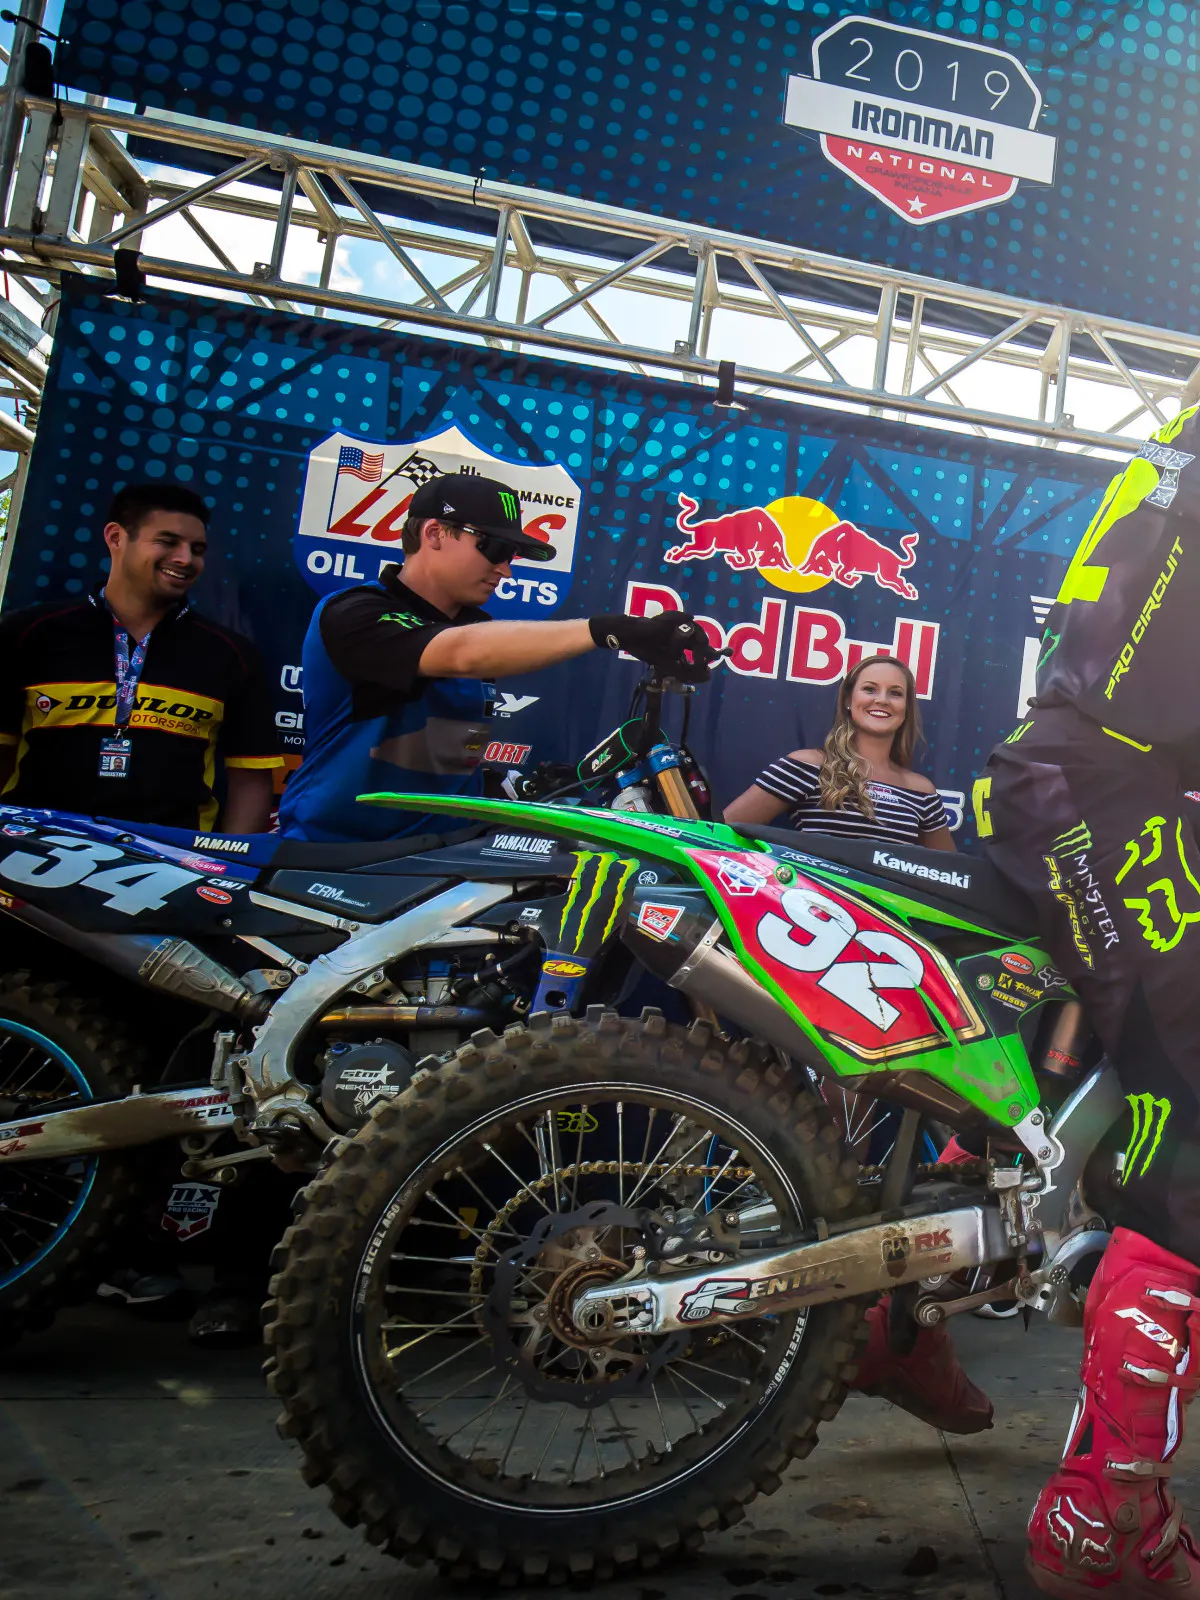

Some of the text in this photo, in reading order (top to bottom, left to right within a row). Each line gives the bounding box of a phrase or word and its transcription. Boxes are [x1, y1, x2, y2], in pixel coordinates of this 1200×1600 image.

[845, 38, 1010, 111] 2019
[851, 100, 995, 160] IRONMAN
[847, 145, 993, 188] NATIONAL
[306, 550, 365, 579] OIL
[1104, 536, 1184, 700] PRO CIRCUIT
[193, 835, 250, 854] YAMAHA
[491, 834, 555, 854] YAMALUBE
[0, 836, 206, 916] 34
[307, 882, 345, 900] CRM
[873, 850, 971, 889] Kawasaki
[1042, 855, 1095, 970] PRO CIRCUIT
[757, 888, 925, 1033] 92
[1004, 956, 1021, 967] Twin
[335, 1083, 400, 1092] REKLUSE
[361, 1229, 387, 1275] EXCEL
[381, 1203, 401, 1229] A60
[914, 1228, 953, 1251] RK
[784, 1317, 806, 1361] EXCEL
[1114, 1307, 1182, 1359] FOX
